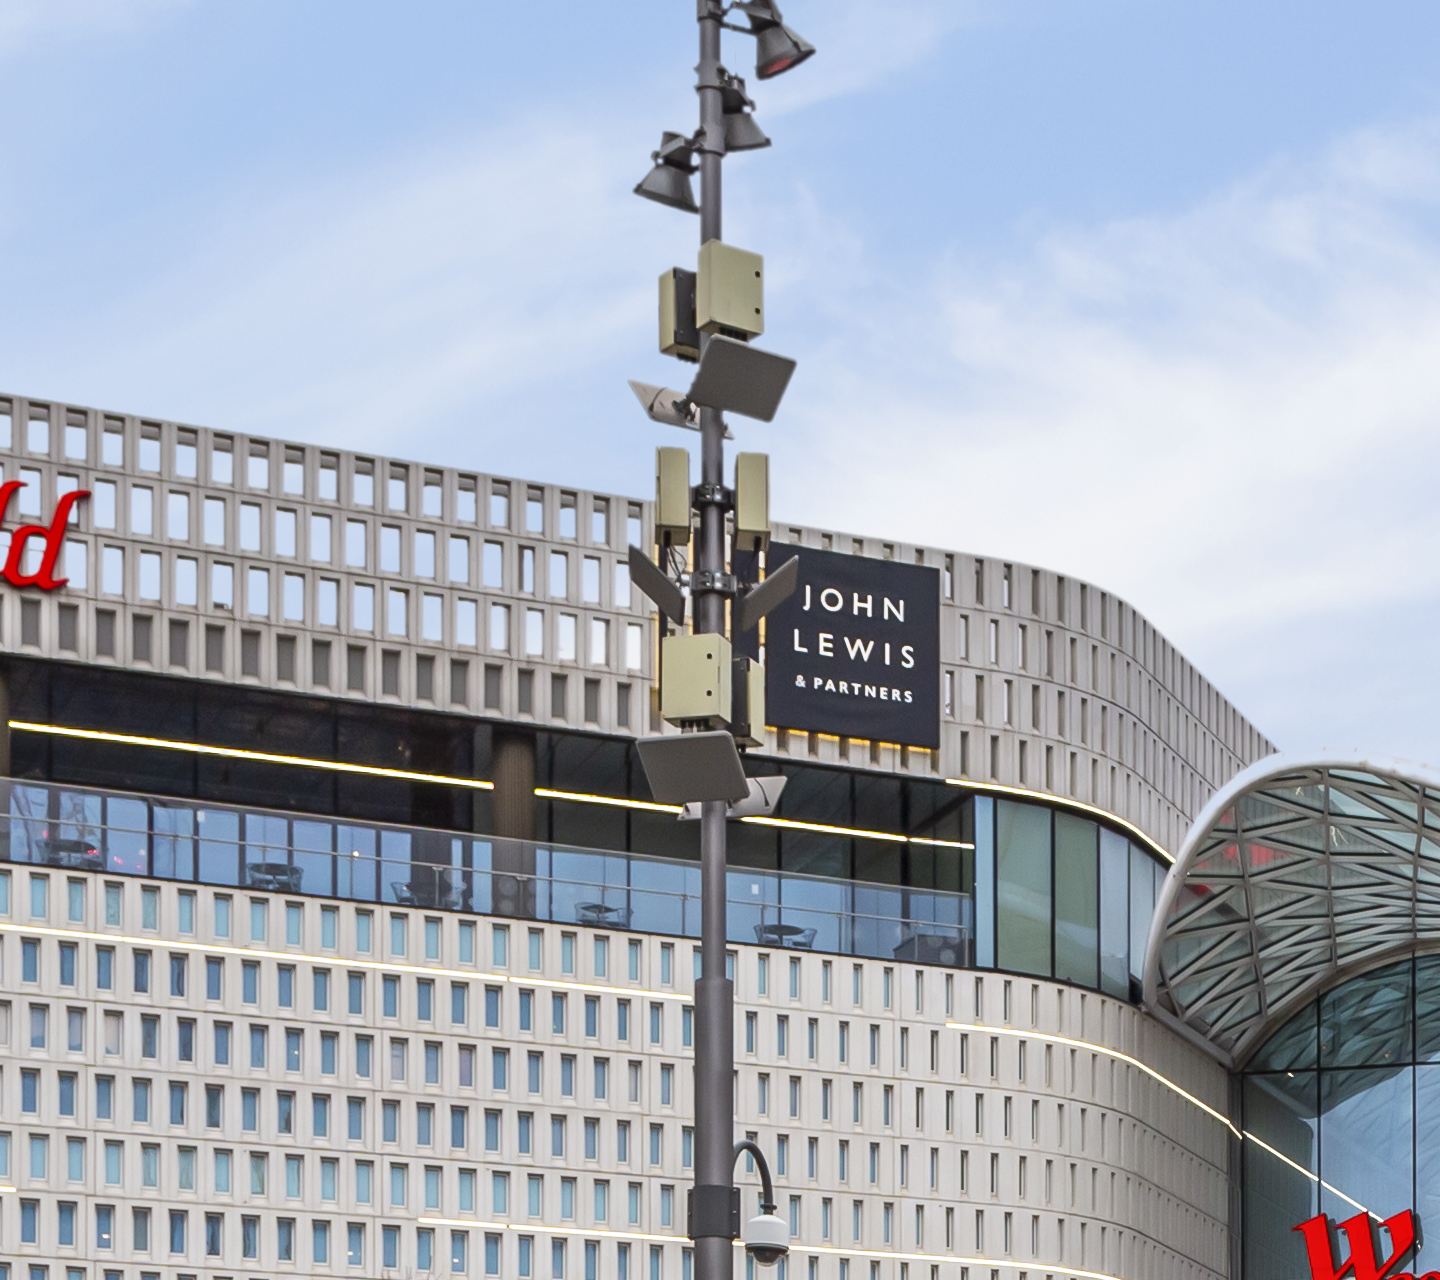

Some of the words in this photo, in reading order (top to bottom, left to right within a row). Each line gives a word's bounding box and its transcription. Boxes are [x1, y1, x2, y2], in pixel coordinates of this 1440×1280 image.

[802, 584, 905, 623] JOHN
[793, 628, 915, 669] LEWIS
[795, 674, 807, 688] &
[813, 677, 913, 703] PARTNERS
